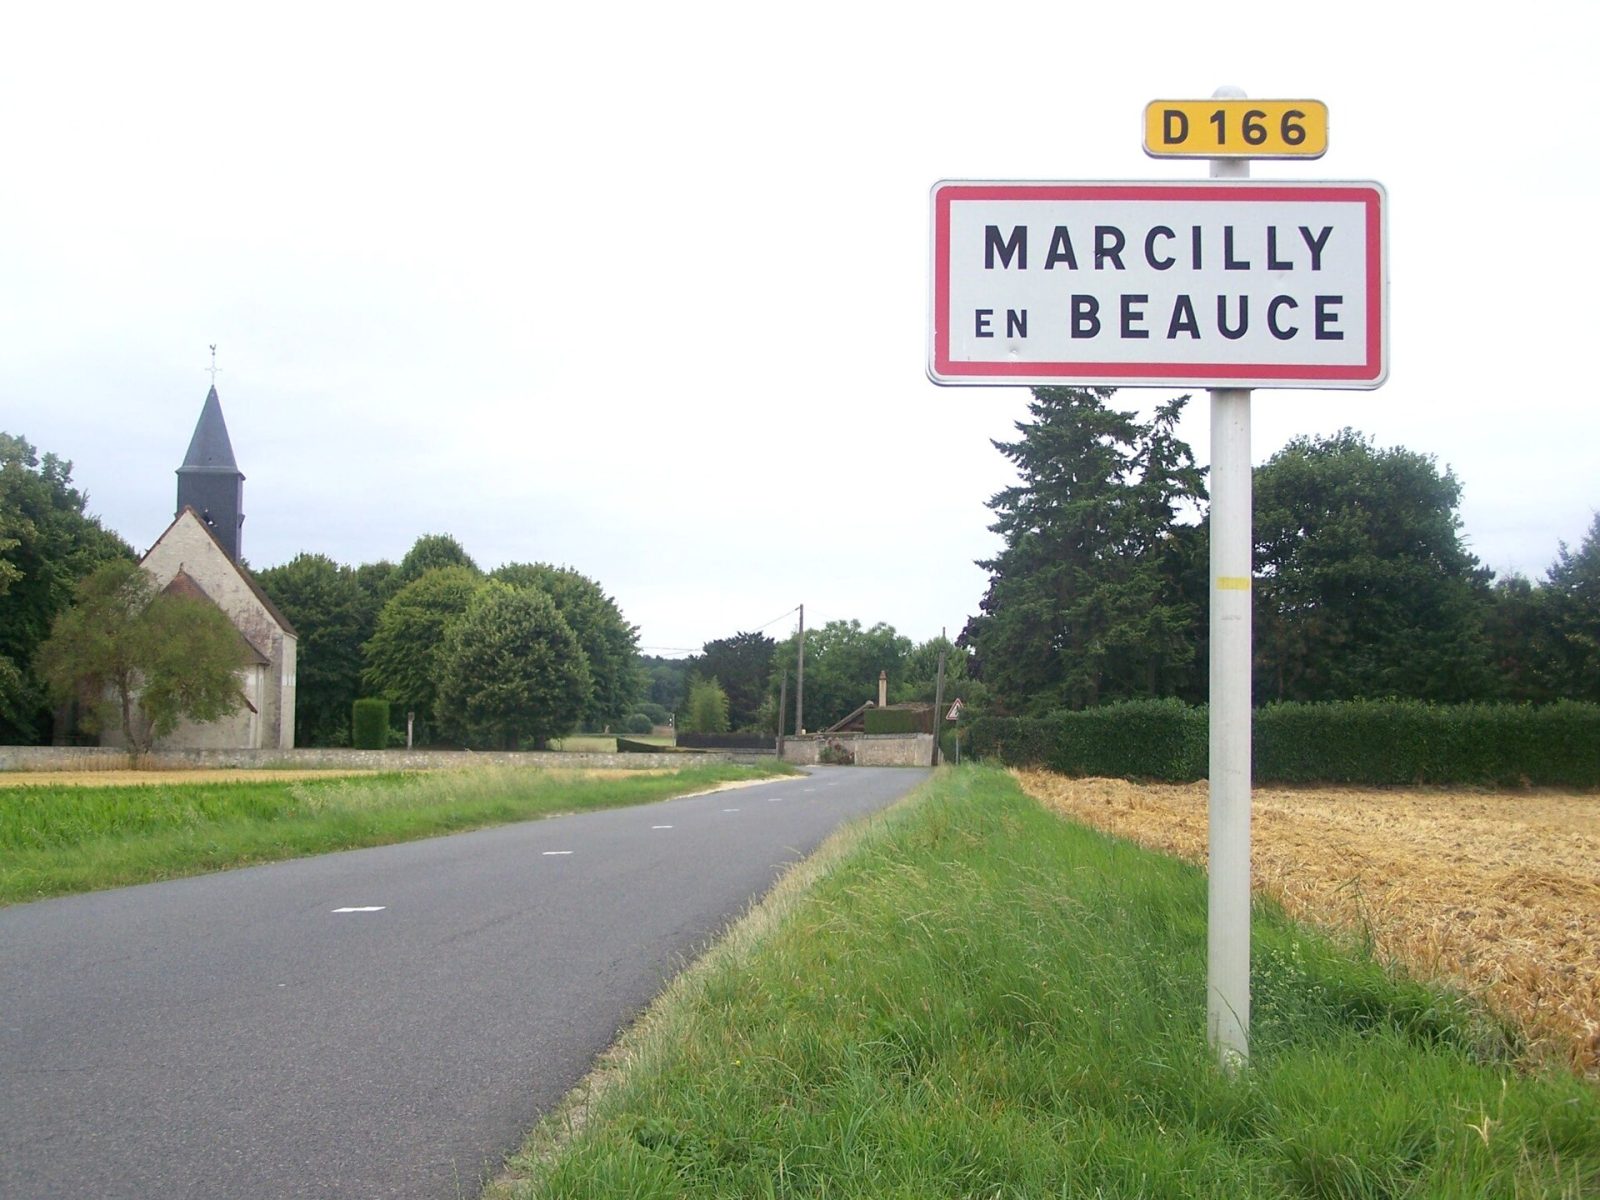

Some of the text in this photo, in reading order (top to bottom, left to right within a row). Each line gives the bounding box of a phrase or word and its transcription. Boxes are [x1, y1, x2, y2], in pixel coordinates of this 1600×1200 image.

[1163, 109, 1306, 146] D 166
[984, 225, 1334, 271] MARCILLY
[975, 294, 1344, 341] EN BEAUCE
